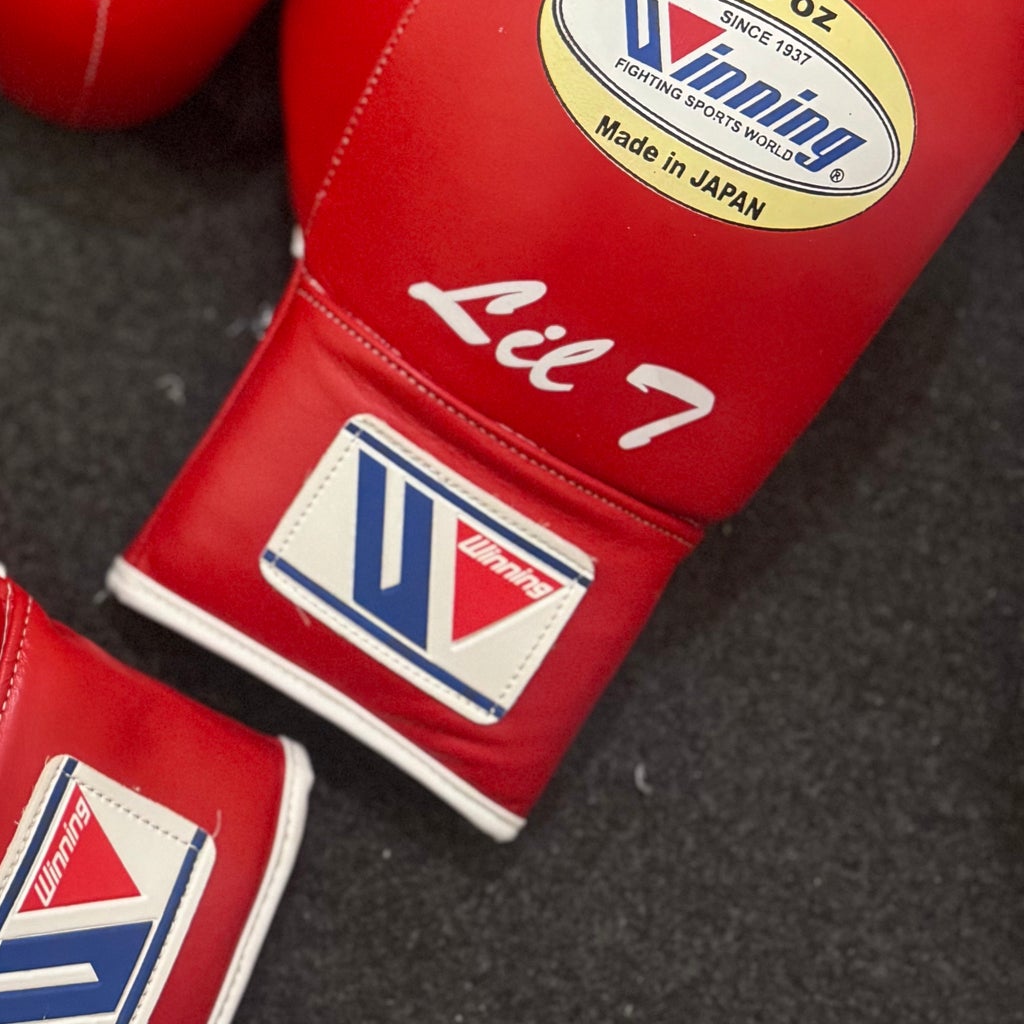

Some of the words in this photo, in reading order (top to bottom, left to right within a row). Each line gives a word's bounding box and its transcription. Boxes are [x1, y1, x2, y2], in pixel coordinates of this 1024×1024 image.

[719, 9, 773, 46] SINCE
[776, 39, 813, 66] 1937
[615, 57, 682, 101] FIGHTING
[684, 95, 742, 133] SPORTS
[744, 126, 795, 162] WORLD
[595, 114, 660, 163] Made
[661, 151, 688, 179] in
[689, 169, 767, 221] JAPAN
[407, 280, 615, 392] Lil
[457, 533, 554, 599] Winning
[34, 798, 92, 907] Winning
